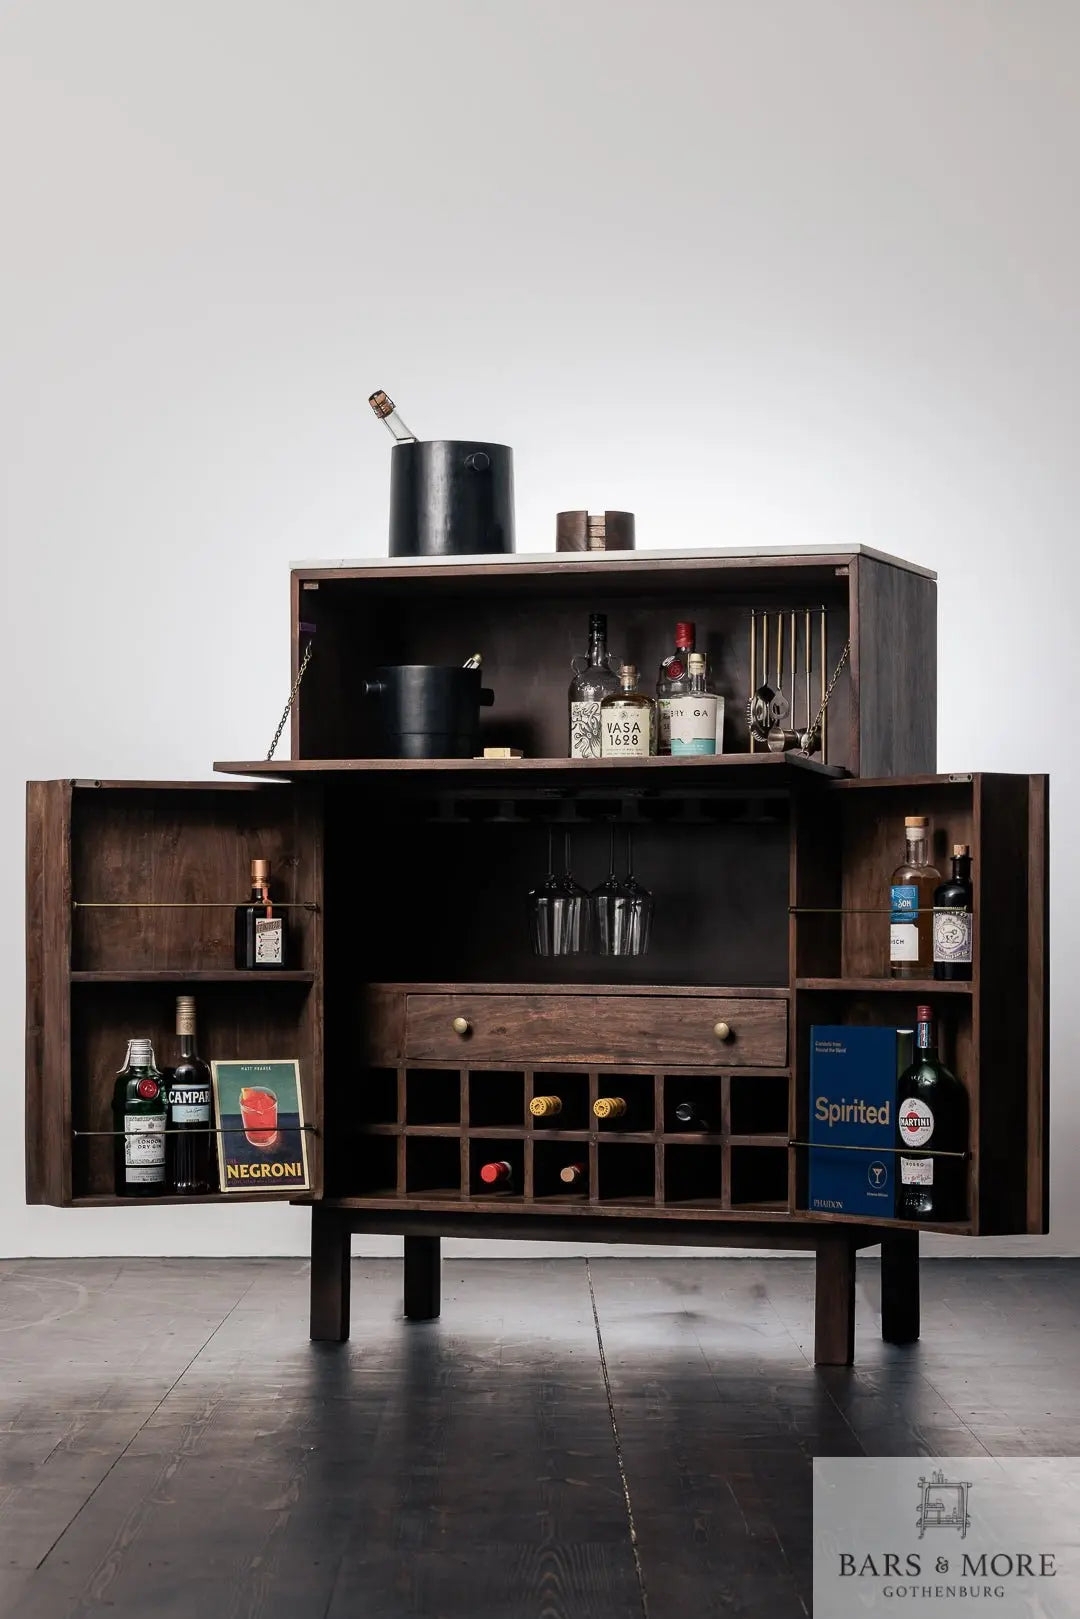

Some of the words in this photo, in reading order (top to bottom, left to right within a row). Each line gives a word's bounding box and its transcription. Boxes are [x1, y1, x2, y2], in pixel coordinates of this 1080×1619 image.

[607, 722, 641, 734] VASA
[609, 734, 639, 746] 1628
[815, 1096, 890, 1128] Spirited
[900, 1117, 930, 1127] MARTINI
[226, 1162, 302, 1179] NEGRONI
